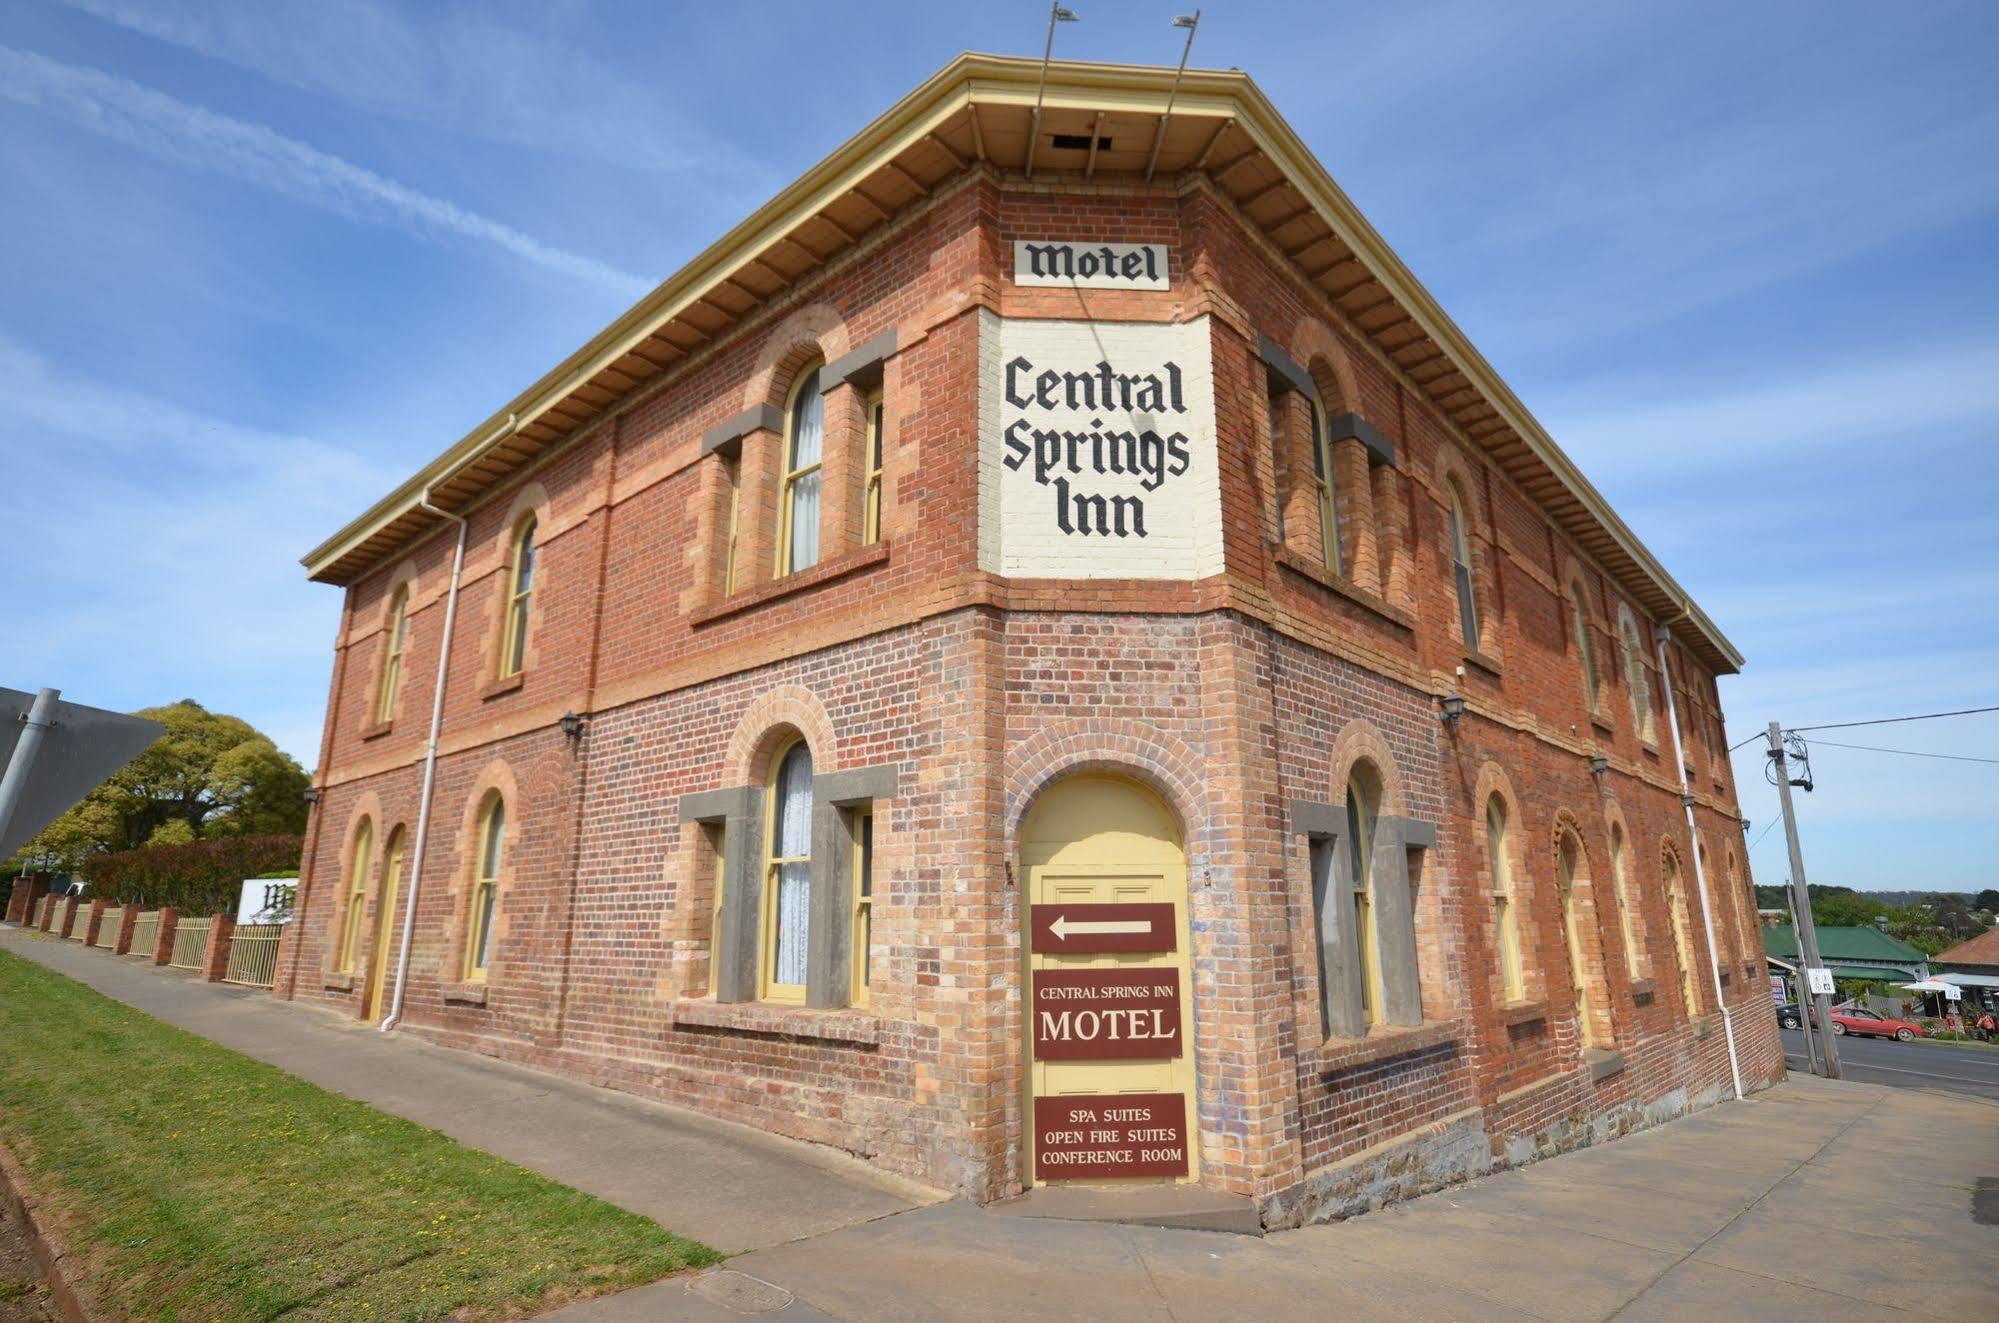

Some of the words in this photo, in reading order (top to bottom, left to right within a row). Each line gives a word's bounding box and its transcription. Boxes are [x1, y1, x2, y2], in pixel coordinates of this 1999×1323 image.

[1025, 244, 1159, 282] Motel
[1005, 356, 1188, 414] Central
[1003, 418, 1190, 492] Springs
[1053, 476, 1148, 538] Inn
[1039, 986, 1100, 1000] CENTRAL
[1100, 986, 1150, 999] SPRINGS
[1153, 985, 1175, 998] INN
[1040, 1009, 1175, 1041] MOTEL
[1068, 1109, 1097, 1123] SPA
[1103, 1108, 1152, 1122] SUITES
[1044, 1131, 1084, 1144] OPEN
[1089, 1130, 1120, 1143] FIRE
[1127, 1128, 1177, 1142] SUITES
[1041, 1151, 1134, 1165] CONFERENCE
[1140, 1148, 1183, 1162] ROOM
